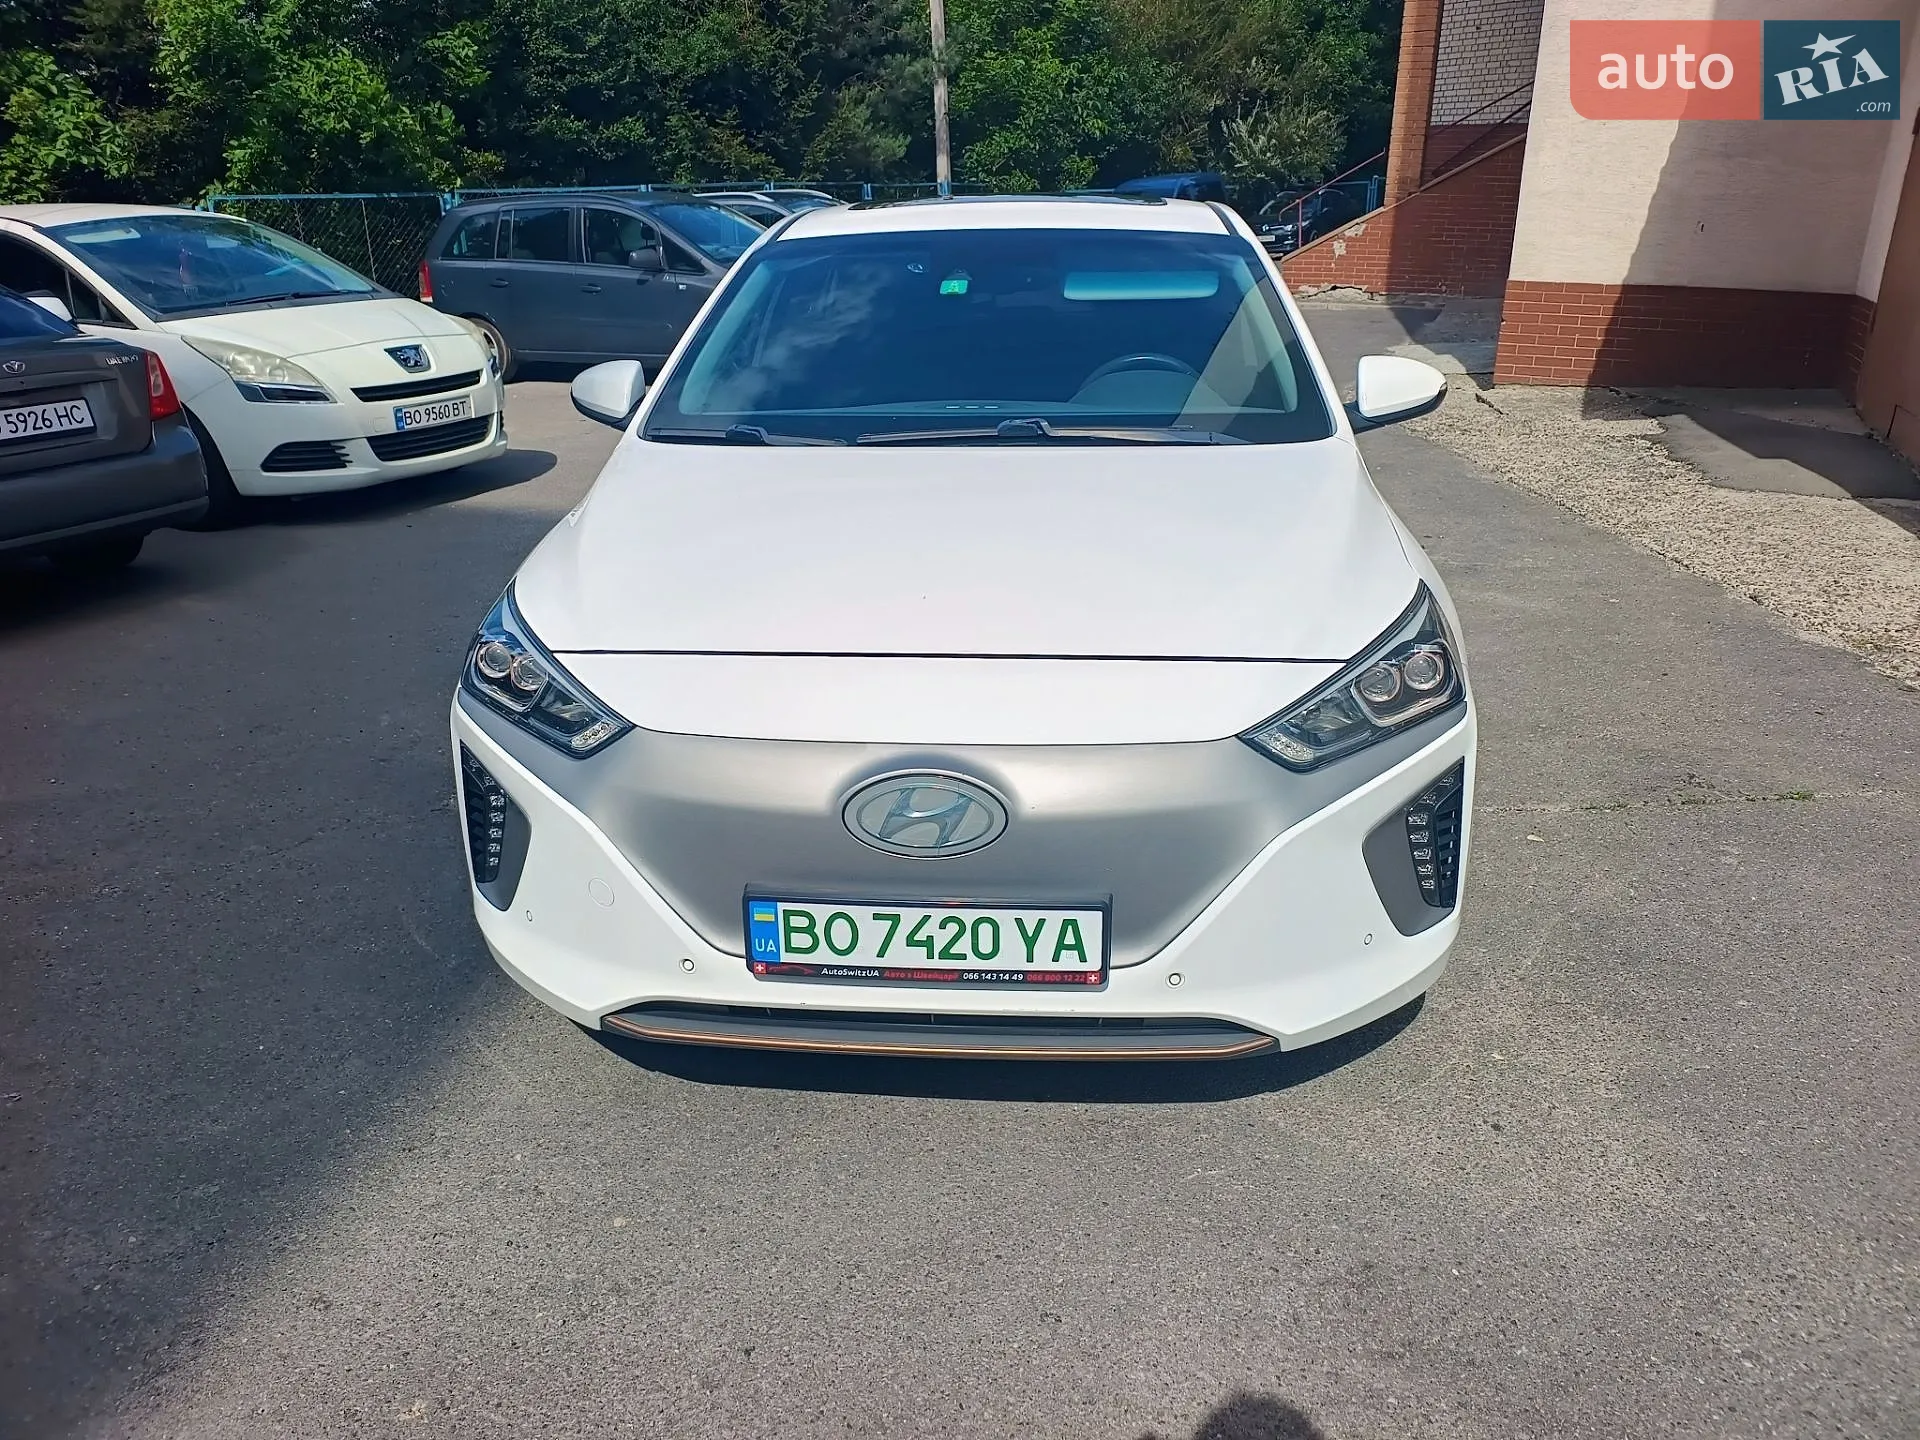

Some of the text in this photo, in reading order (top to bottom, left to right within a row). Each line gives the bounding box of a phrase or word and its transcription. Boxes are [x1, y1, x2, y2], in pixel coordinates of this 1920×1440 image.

[3, 404, 85, 434] 5926 HC
[404, 410, 422, 426] BO
[424, 404, 451, 423] 9560
[452, 400, 467, 417] BT
[755, 938, 777, 953] UA
[782, 909, 1088, 964] BO 7420 YA
[821, 967, 880, 978] AutoSwitzUA
[962, 972, 1025, 982] 066 143 14 49
